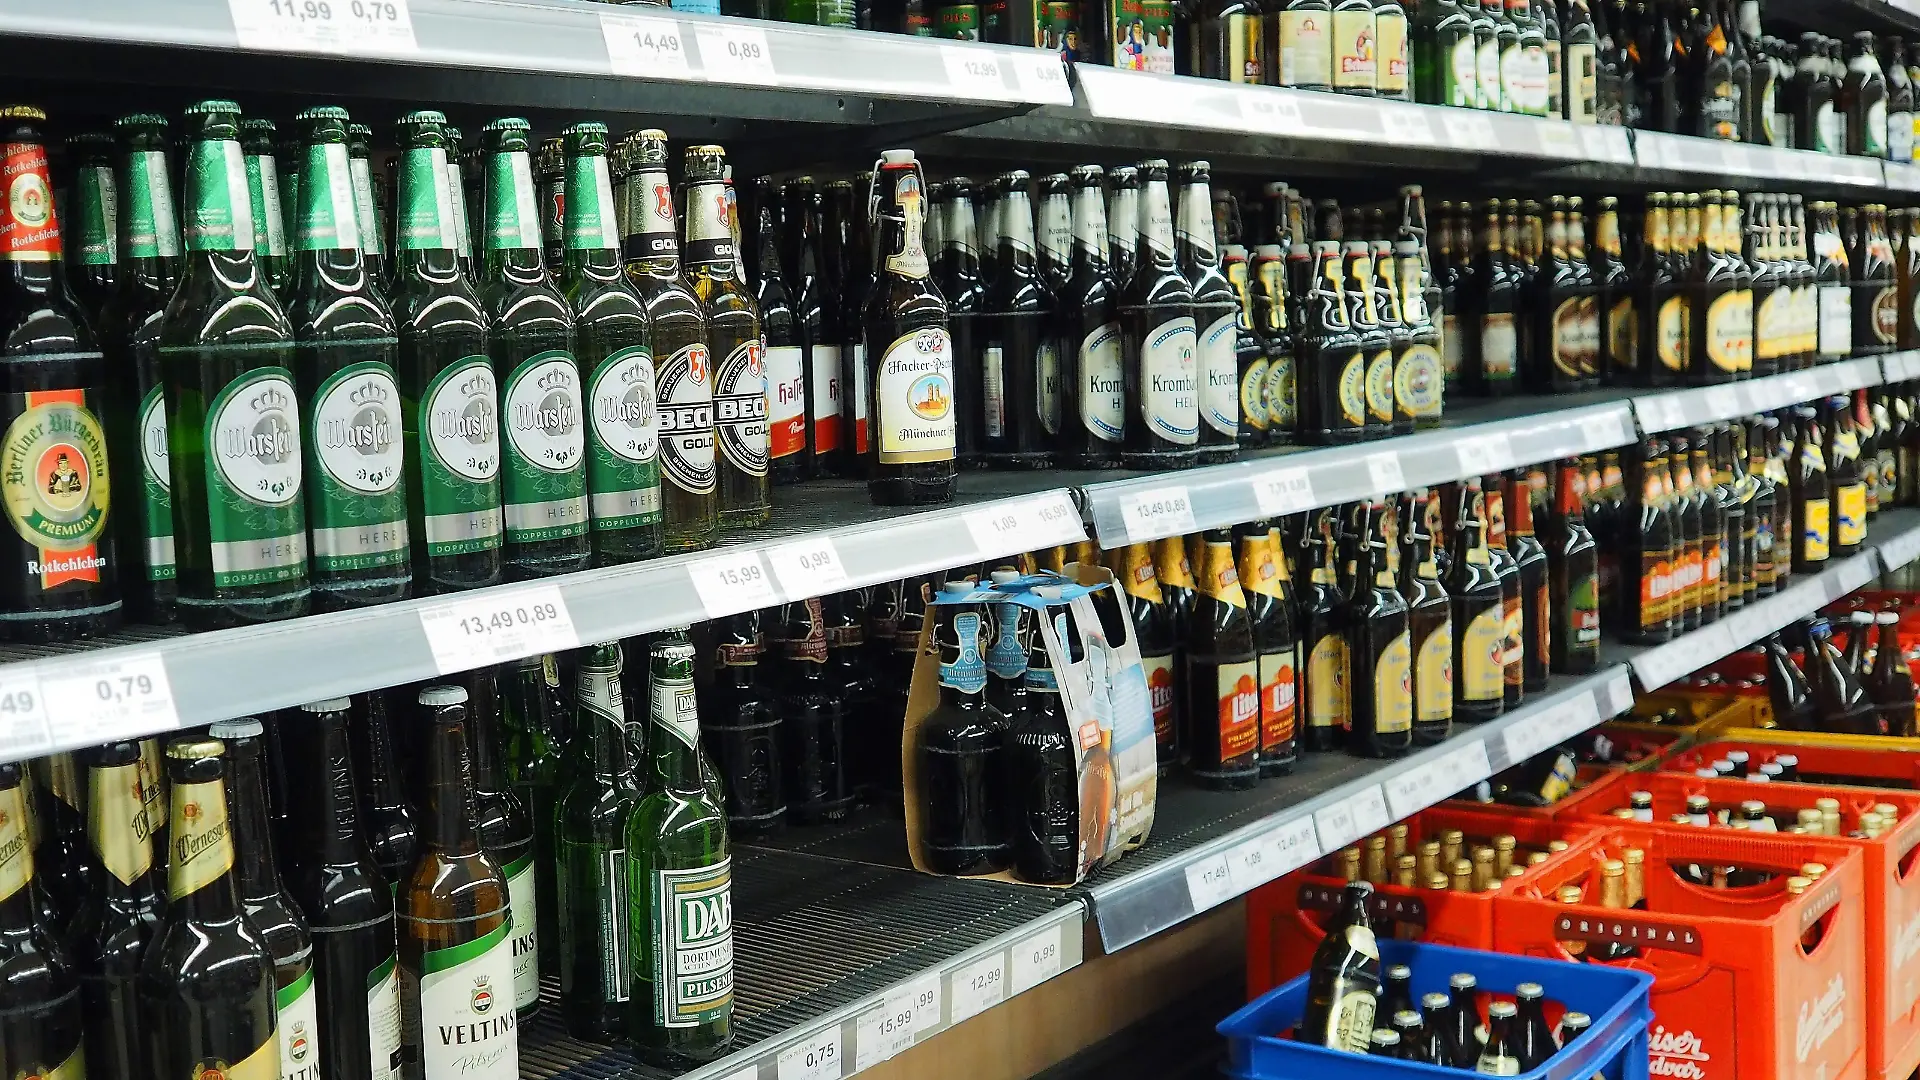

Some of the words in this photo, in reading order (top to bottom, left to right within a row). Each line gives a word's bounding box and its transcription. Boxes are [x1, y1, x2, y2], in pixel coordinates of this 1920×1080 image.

[270, 0, 331, 22] 11,99
[351, 0, 397, 22] 0,79
[633, 31, 679, 52] 14,49
[727, 40, 761, 60] 0,89
[963, 61, 997, 77] 12,99
[1037, 65, 1060, 81] 0,99
[6, 420, 46, 487] Berliner
[547, 504, 582, 519] HERB
[1038, 503, 1069, 524] 16,99
[1137, 501, 1164, 520] 13,49
[1165, 497, 1186, 514] 0,89
[37, 514, 95, 537] PREMIUM
[992, 514, 1018, 534] 1,09
[359, 530, 398, 545] HERB
[27, 554, 107, 577] Rotkehlchen
[800, 550, 832, 573] 0,99
[719, 564, 762, 587] 15,99
[460, 610, 514, 637] 13,49
[516, 602, 559, 627] 0,89
[96, 673, 153, 703] 0,79
[1244, 850, 1262, 868] 1,09
[1203, 865, 1226, 885] 17,49
[685, 889, 733, 941] DAB
[1560, 918, 1696, 944] ORIGINAL
[1033, 943, 1055, 965] 0,99
[970, 967, 1001, 992] 12,99
[438, 1009, 514, 1046] VELTINS
[878, 1009, 912, 1036] 15,99
[806, 1042, 835, 1068] 0,75
